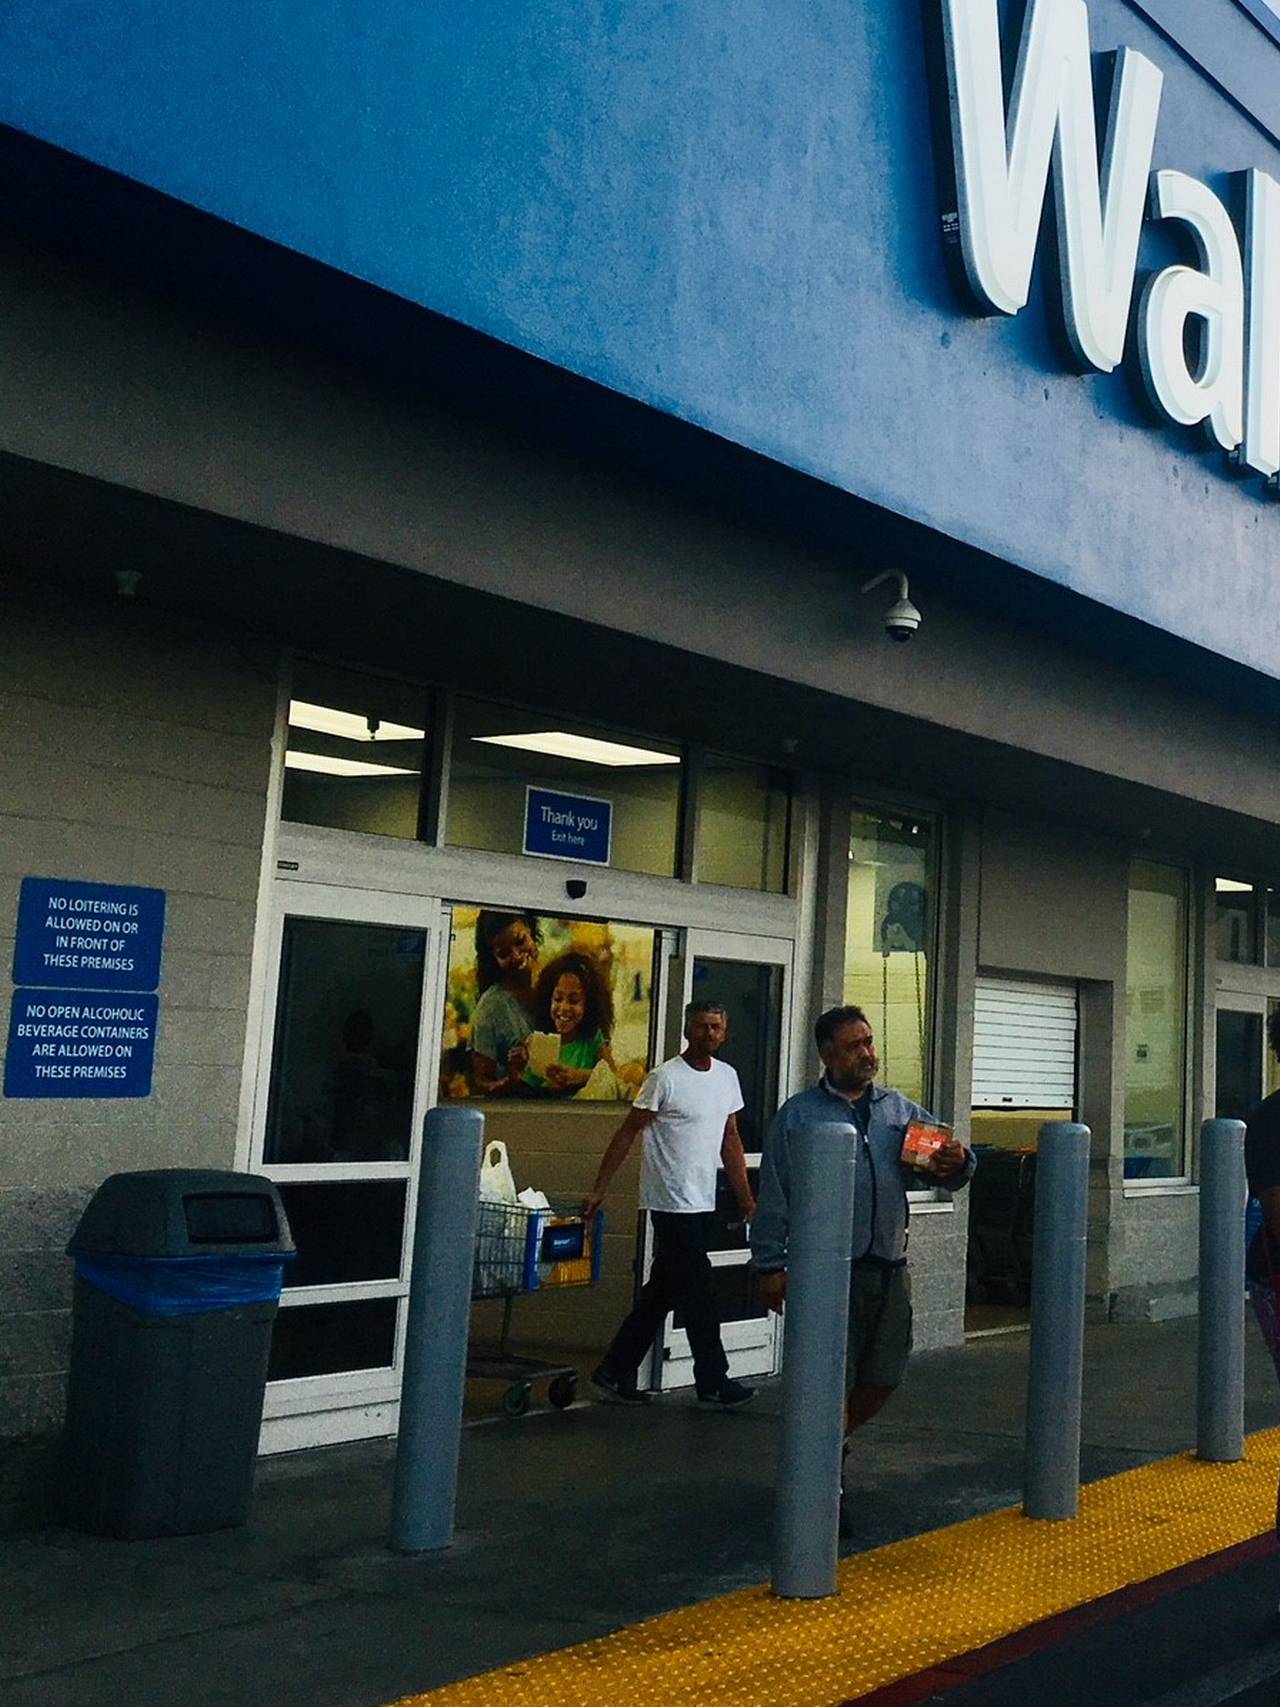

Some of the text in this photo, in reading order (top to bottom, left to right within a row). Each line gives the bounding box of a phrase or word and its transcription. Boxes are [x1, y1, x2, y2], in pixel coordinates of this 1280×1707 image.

[541, 805, 598, 832] Thank you
[551, 829, 585, 846] Exit here
[48, 897, 139, 917] NO LOITERING IS
[45, 916, 139, 934] ALLOWED ON OR
[56, 935, 126, 951] IN FRONT OF
[43, 953, 134, 971] THESE PREMISES
[26, 1005, 145, 1021] NO OPEN ALCOHOLIC
[17, 1024, 149, 1040] BEVERAGE CONTAINERS
[32, 1043, 133, 1058] ARE ALLOWED ON
[34, 1065, 127, 1079] THESE PREMISES
